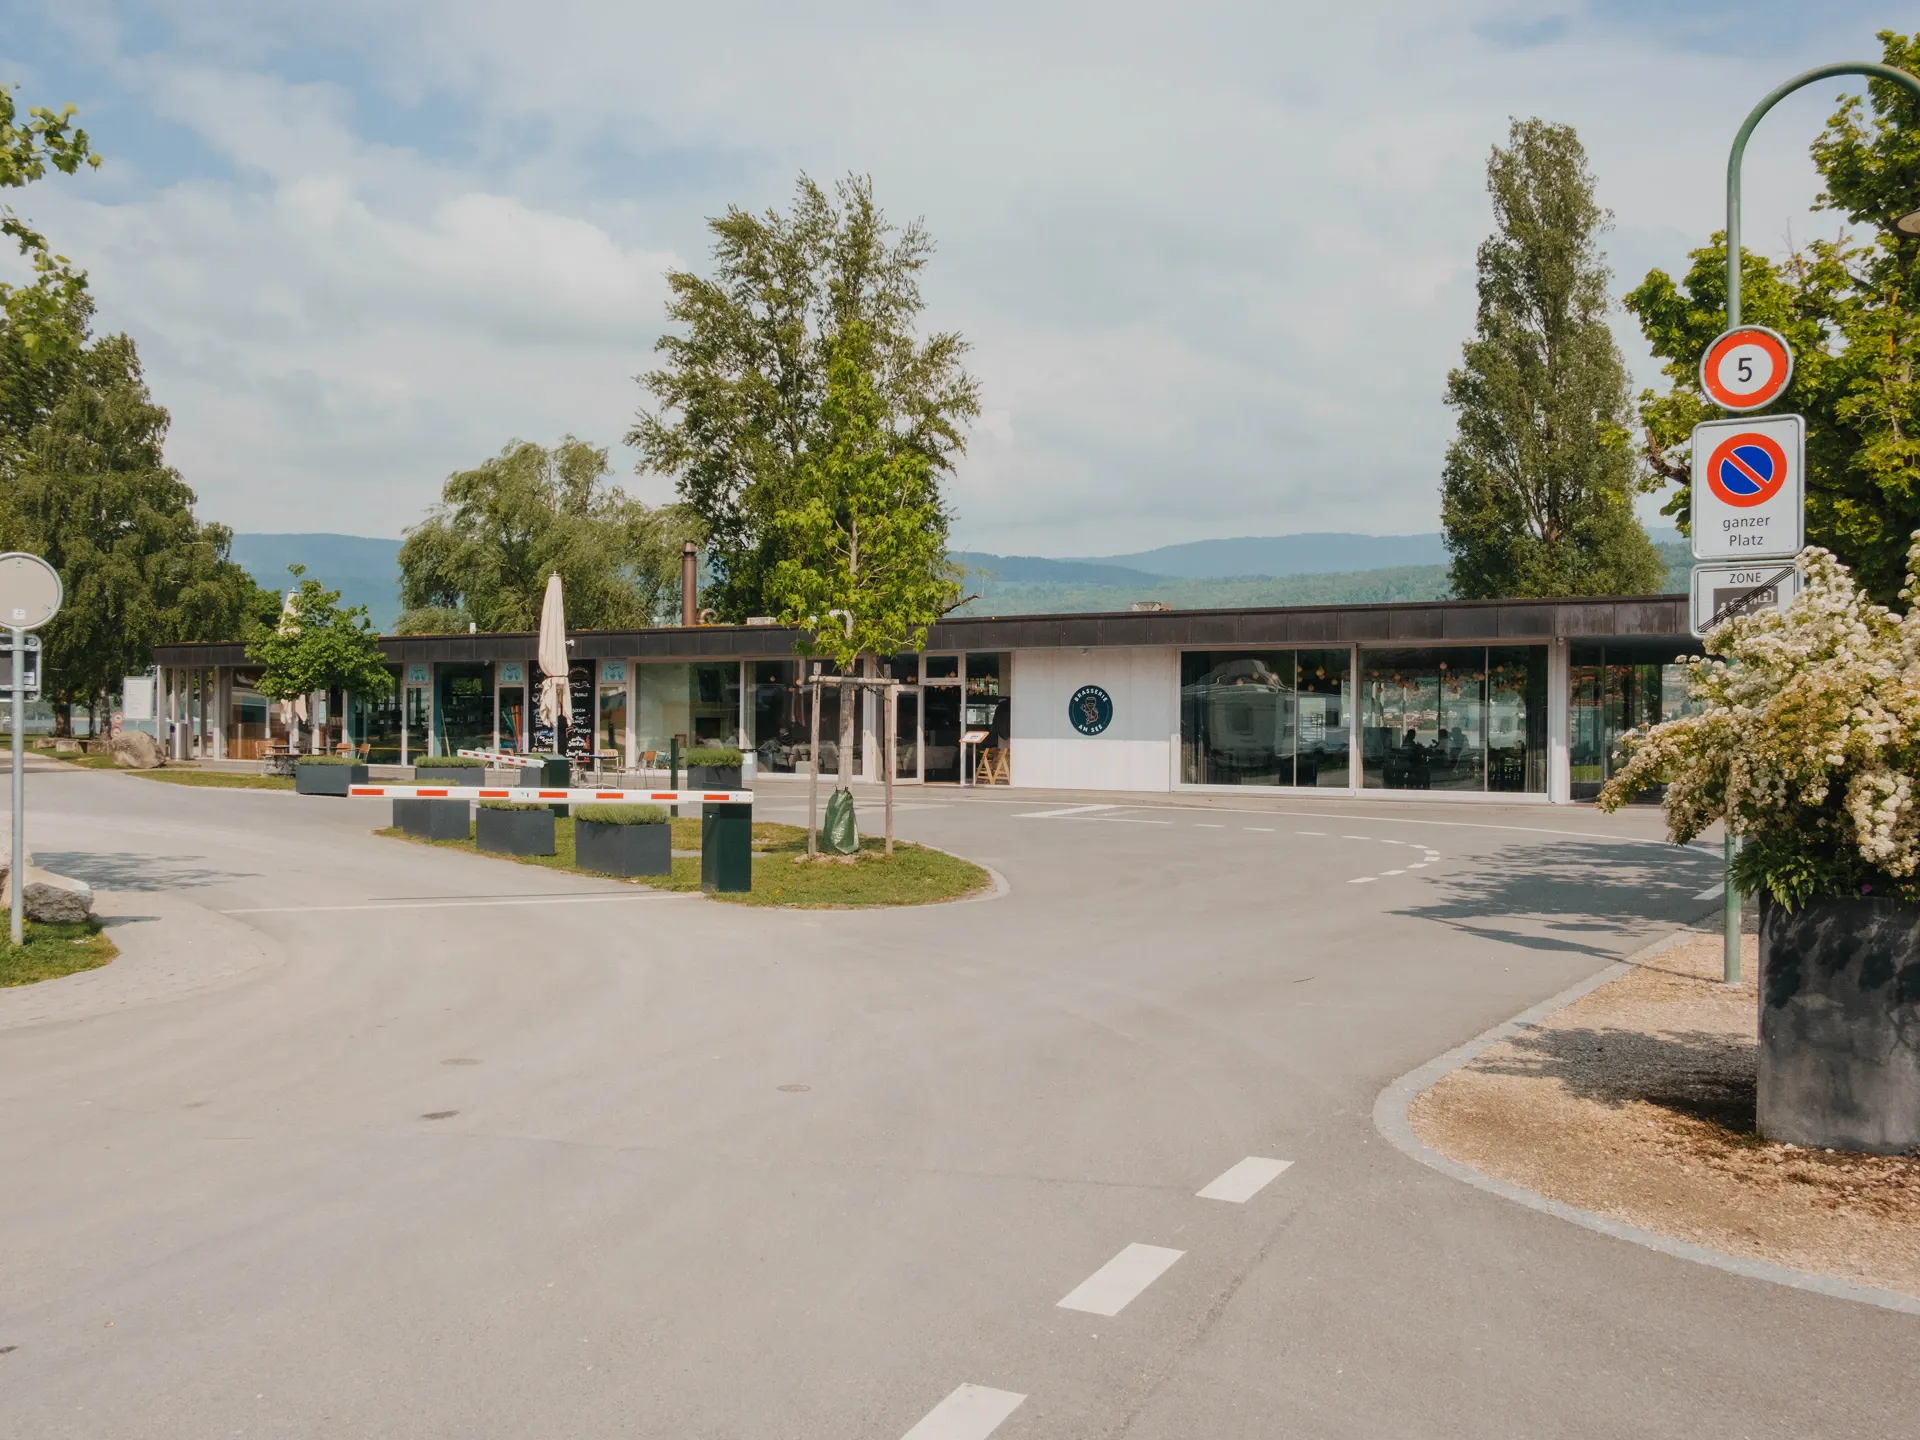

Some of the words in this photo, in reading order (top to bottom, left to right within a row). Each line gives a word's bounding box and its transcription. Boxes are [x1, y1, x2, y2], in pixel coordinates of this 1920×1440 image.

[1738, 357, 1753, 383] 5
[1722, 516, 1771, 532] ganzer
[1729, 534, 1764, 547] Platz
[1729, 572, 1762, 584] ZONE
[1074, 688, 1108, 702] BRASSERIE
[1078, 724, 1088, 732] AM
[1091, 724, 1103, 733] SEE
